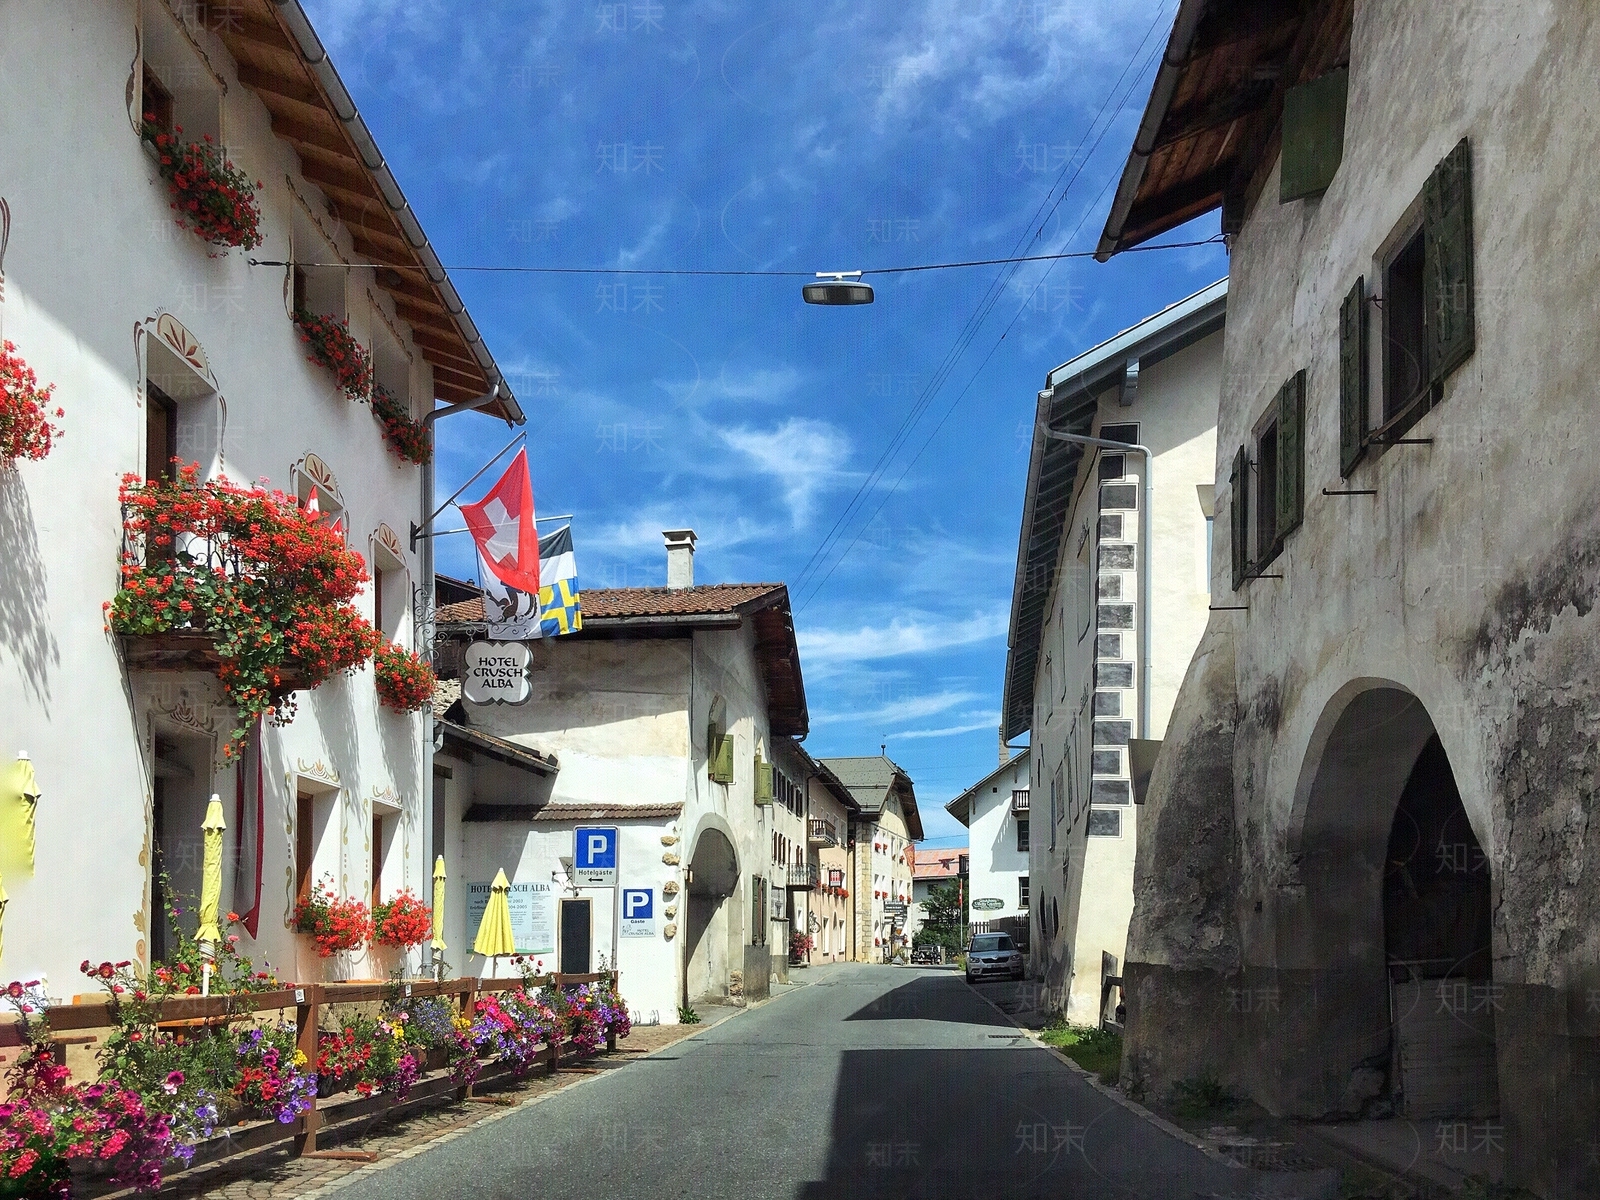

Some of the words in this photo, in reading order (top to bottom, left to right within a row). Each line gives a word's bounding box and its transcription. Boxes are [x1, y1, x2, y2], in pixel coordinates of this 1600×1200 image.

[478, 657, 518, 667] HOTEL
[473, 668, 523, 678] CRUSCH
[481, 679, 514, 689] ALBA
[587, 835, 608, 864] P
[470, 885, 492, 893] HOTE
[530, 884, 551, 892] ALBA
[626, 891, 650, 917] P
